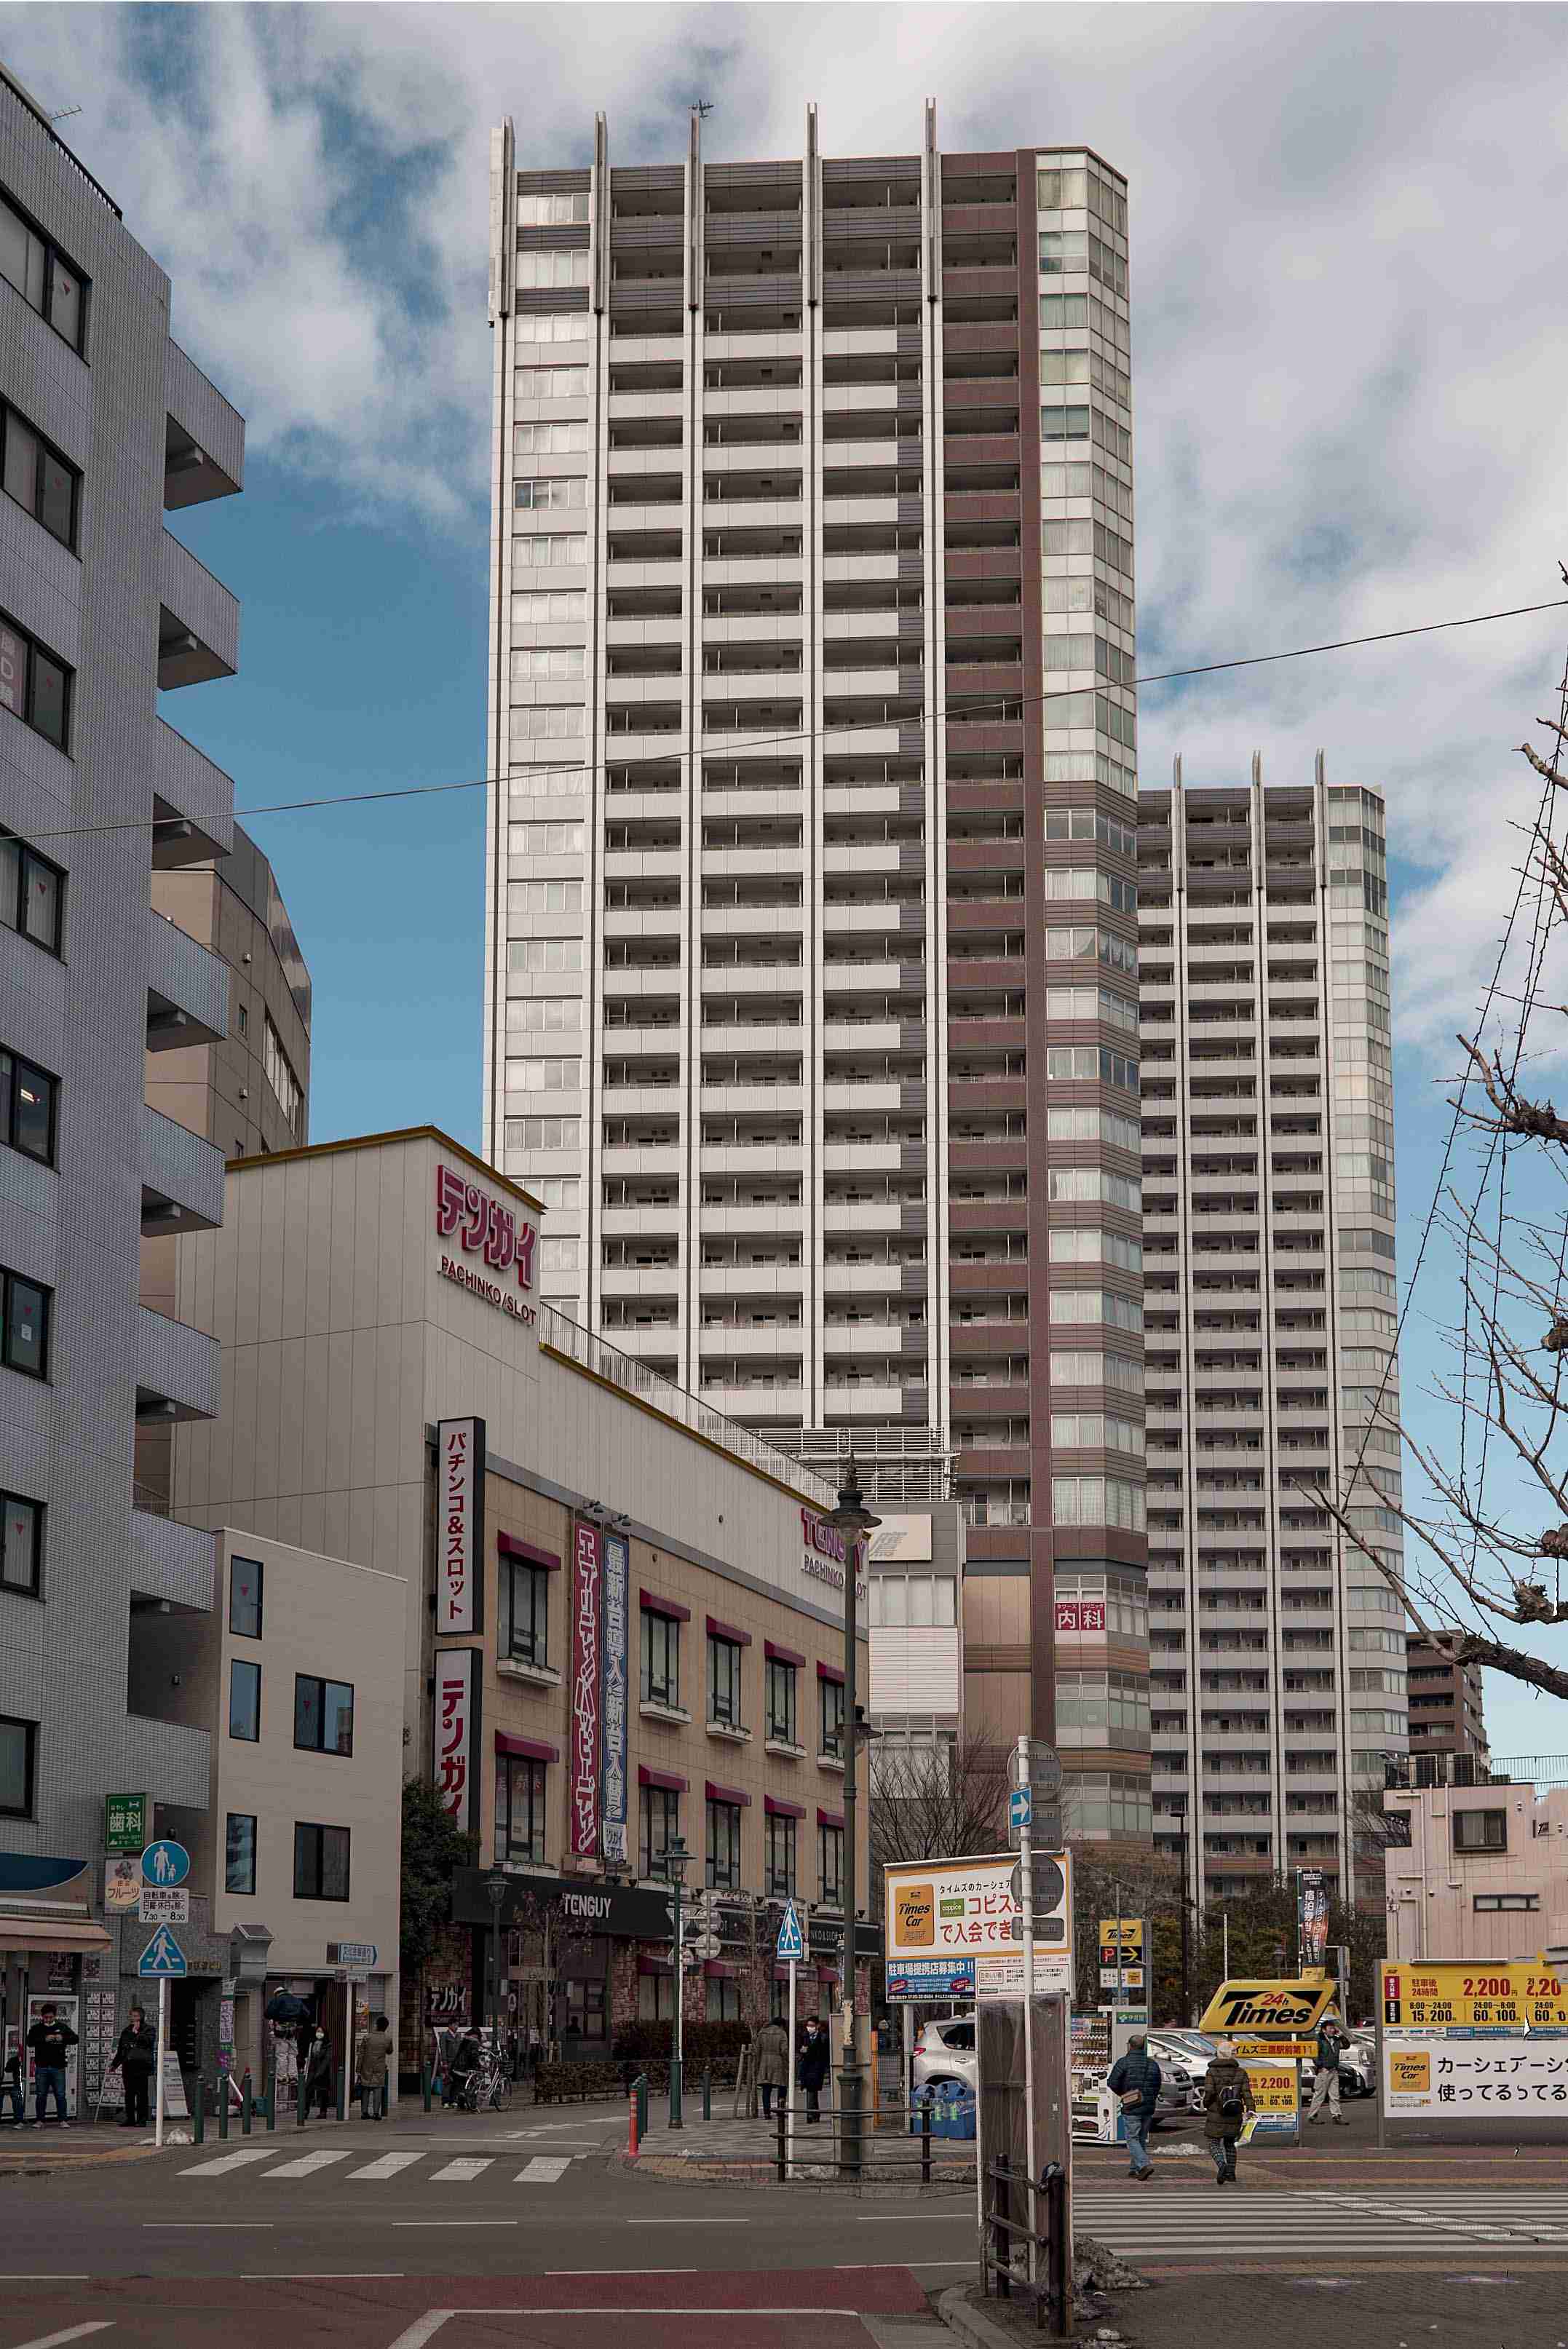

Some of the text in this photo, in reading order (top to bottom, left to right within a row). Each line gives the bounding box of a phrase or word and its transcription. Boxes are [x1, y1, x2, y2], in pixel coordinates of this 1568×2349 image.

[437, 1165, 537, 1289] テンガイ
[440, 1254, 537, 1326] PACHINKO/SLOT
[447, 1432, 467, 1620] パチンコ&スロット
[1058, 1609, 1104, 1629] 内科
[110, 1812, 141, 1832] 歯科
[108, 1887, 140, 1899] フルーツ
[561, 1892, 611, 1919] TENGUY
[898, 1903, 930, 1916] Times
[905, 1916, 924, 1928] Car
[1102, 1947, 1114, 1962] P
[1261, 1993, 1288, 2005] 24h
[1224, 2000, 1312, 2027] Times
[1235, 2045, 1312, 2055] イムズ三鷹駅前第11
[1393, 2062, 1427, 2072] Times
[1401, 2071, 1419, 2080] Car
